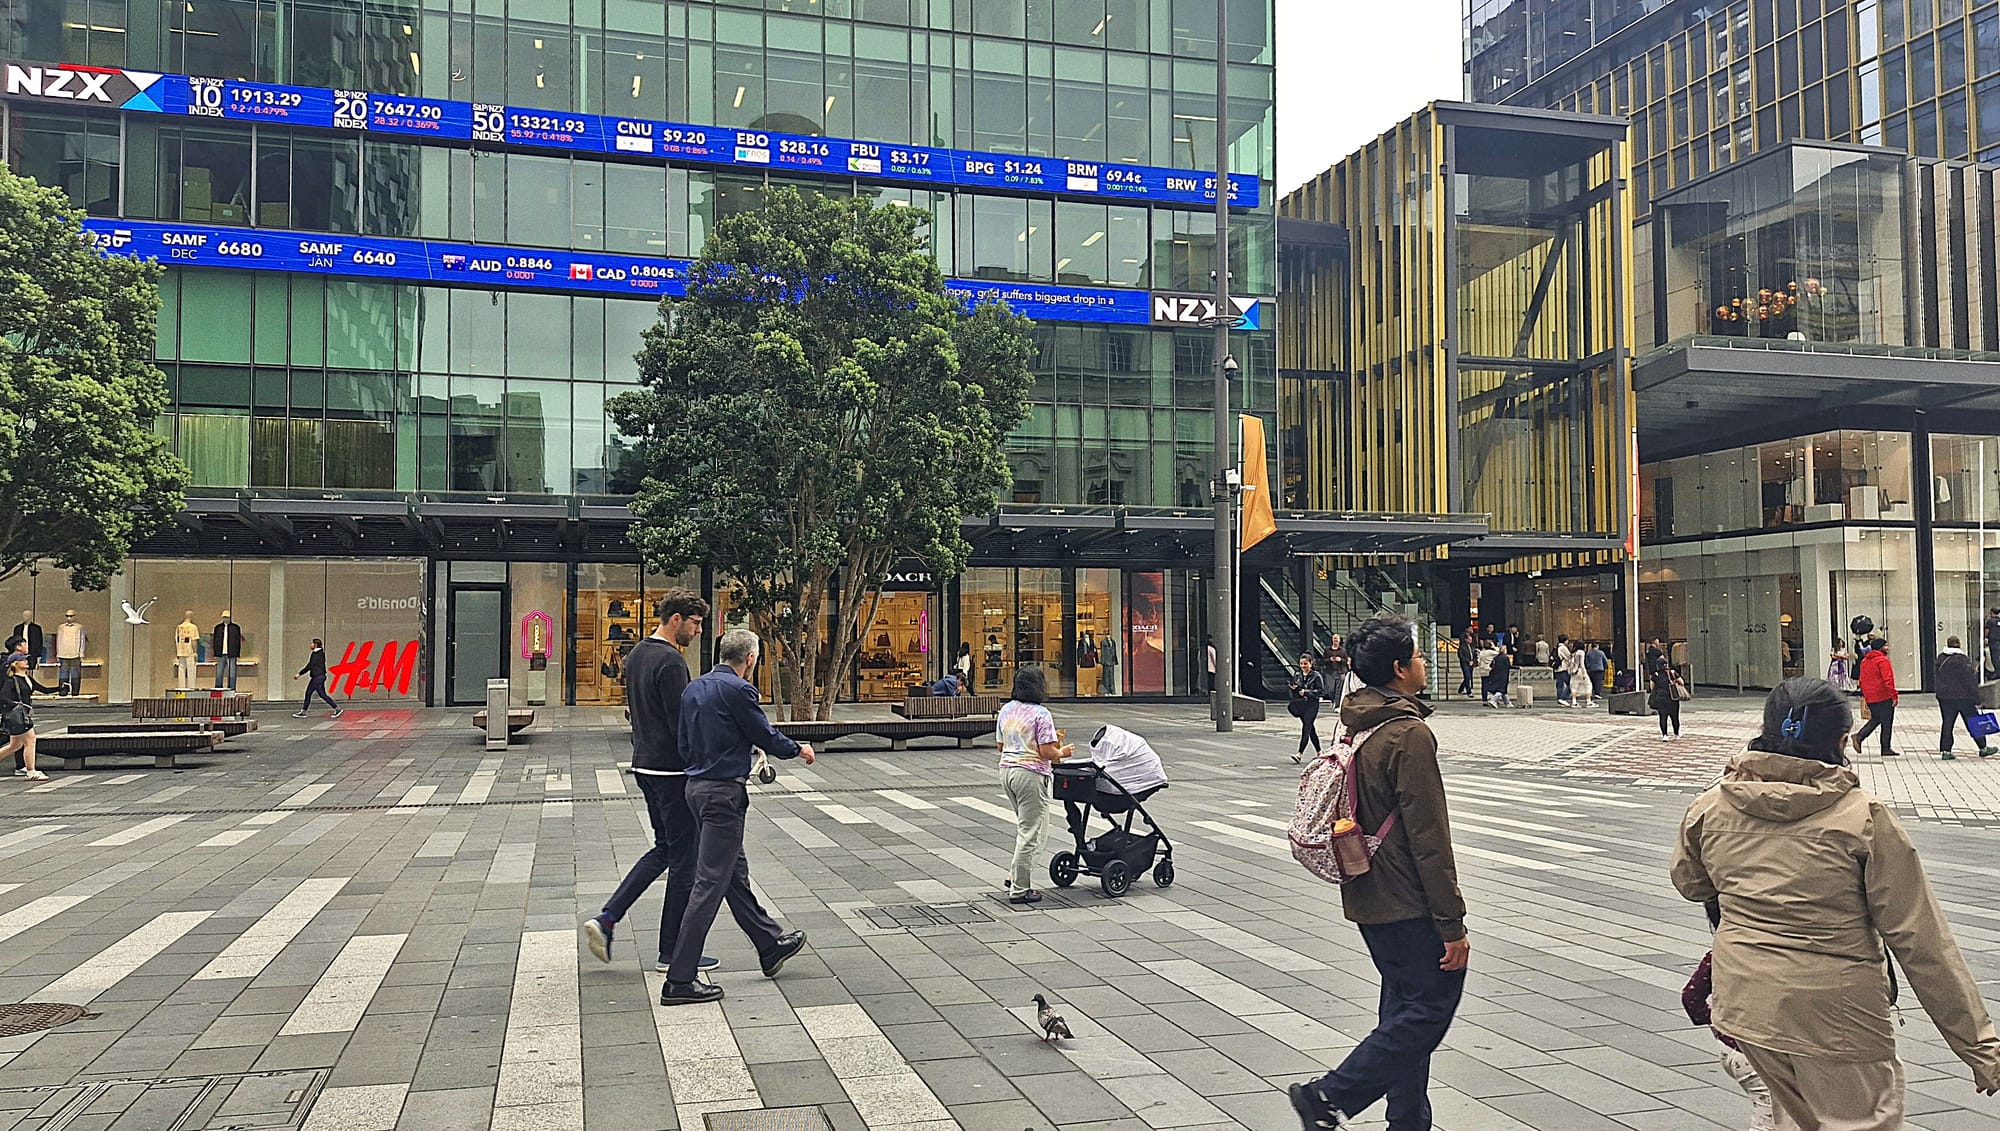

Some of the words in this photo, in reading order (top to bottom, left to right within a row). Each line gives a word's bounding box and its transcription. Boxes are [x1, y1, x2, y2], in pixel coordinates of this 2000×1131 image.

[6, 64, 112, 103] NZX
[189, 76, 224, 87] S&P/NZX
[192, 84, 221, 107] 10
[231, 88, 302, 106] 1913.29
[334, 89, 368, 100] S&P/NZX
[188, 104, 224, 117] INDEX
[231, 104, 246, 113] 9.2
[254, 106, 289, 117] 0.479%
[334, 98, 367, 120] 20
[374, 101, 442, 119] 7647.90
[472, 103, 505, 114] S&P/NZX
[333, 117, 368, 130] INDEX
[374, 116, 399, 126] 28.32
[406, 119, 440, 130] 0.369%
[472, 111, 505, 132] 50
[511, 114, 585, 133] 13321.93
[472, 130, 505, 142] INDEX
[511, 129, 534, 139] 55.92
[542, 132, 573, 142] 0.418%
[617, 121, 652, 136] CNU
[663, 128, 706, 145] $9.20
[736, 132, 769, 147] EBO
[779, 139, 829, 156] $28.16
[850, 143, 879, 157] FBU
[890, 150, 929, 165] $3.17
[891, 165, 906, 173] 0.02
[965, 161, 994, 175] BPG
[1004, 160, 1042, 175] $1.24
[1067, 162, 1098, 177] BRM
[1106, 170, 1142, 184] 69.4¢
[1166, 178, 1197, 191] BRW
[162, 232, 207, 246] SAMF
[171, 248, 198, 259] DEC
[217, 241, 263, 257] 6680
[299, 241, 343, 255] SAMF
[308, 256, 333, 268] JAN
[353, 250, 396, 266] 6640
[469, 259, 502, 272] AUD
[506, 256, 553, 270] 0.8846
[506, 270, 535, 279] 0.0001
[596, 268, 626, 280] CAD
[631, 265, 674, 278] 0.8045
[1002, 289, 1033, 301] suffers
[1035, 291, 1071, 304] biggest
[1073, 293, 1096, 307] drop
[1097, 295, 1106, 305] in
[1108, 297, 1114, 305] a
[1154, 296, 1217, 323] NZX
[328, 640, 420, 696] H&M
